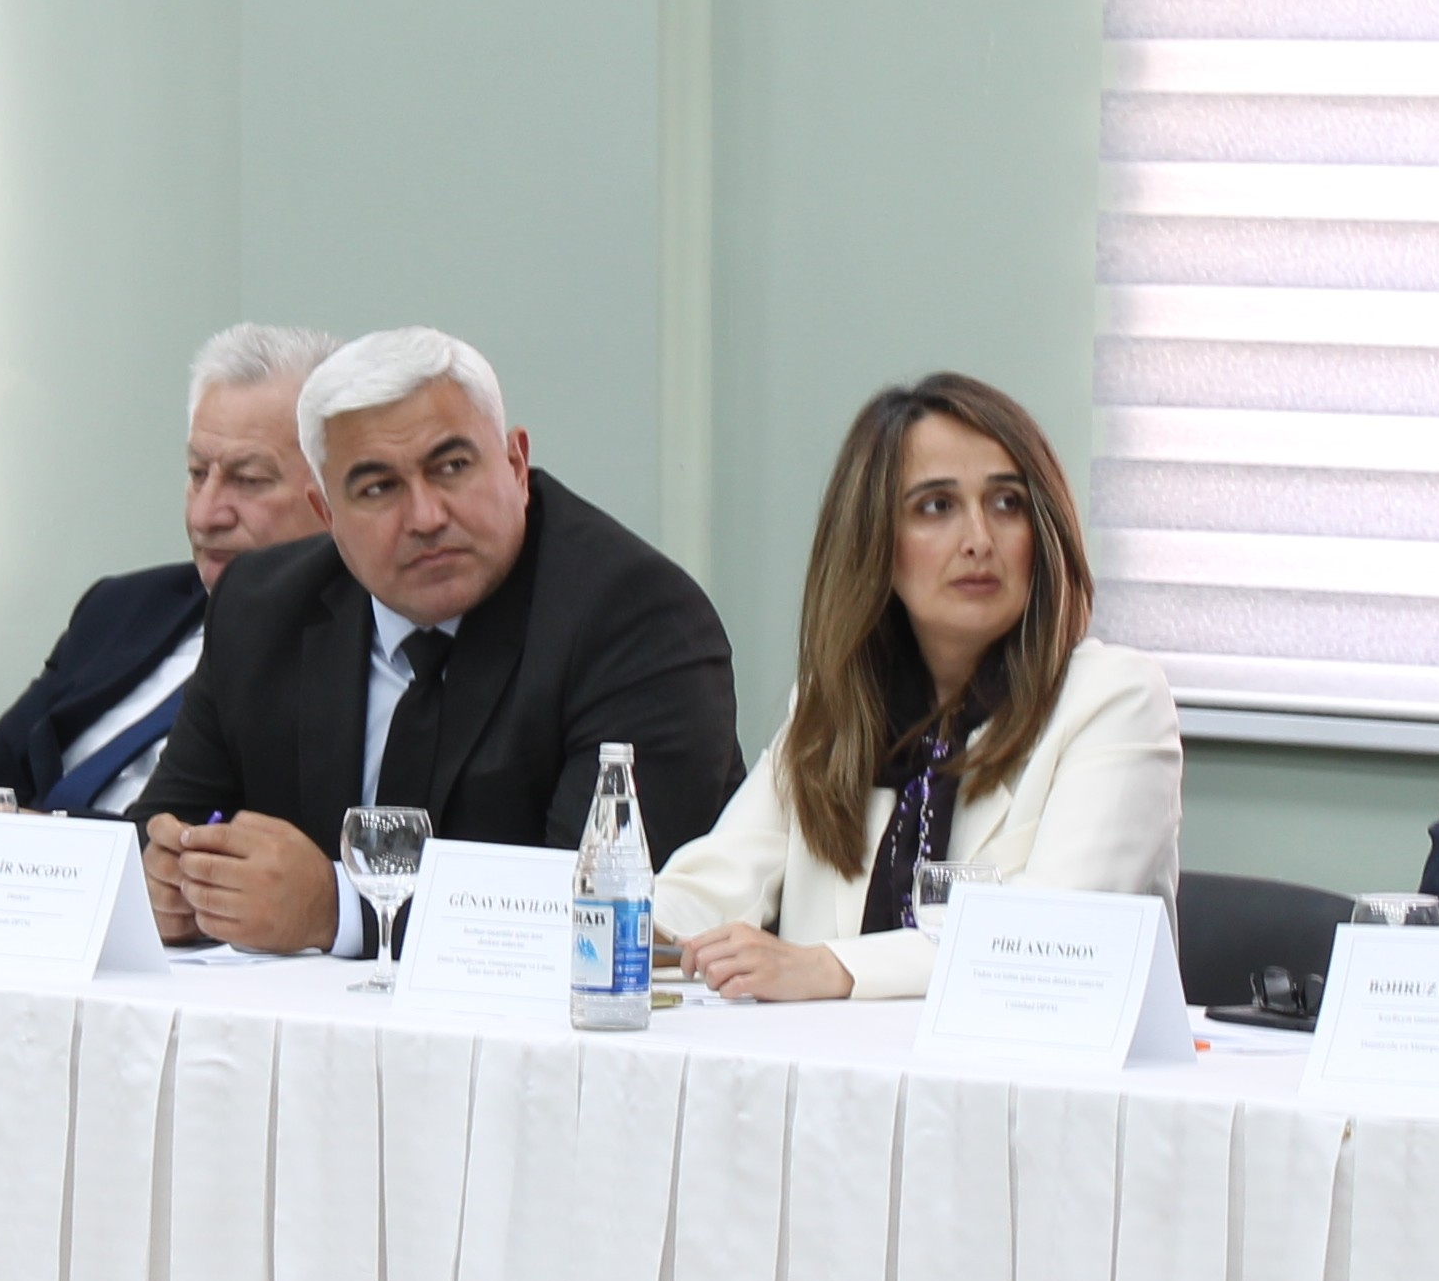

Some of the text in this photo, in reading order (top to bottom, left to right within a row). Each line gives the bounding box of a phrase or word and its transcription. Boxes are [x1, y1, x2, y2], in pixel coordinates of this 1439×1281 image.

[16, 862, 83, 879] NƏCƏFOV
[449, 891, 497, 910] GÜNAY
[573, 910, 606, 925] RAB
[990, 935, 1099, 960] PİRİ AXUNDOV
[1369, 978, 1437, 998] BƏHRUZ
